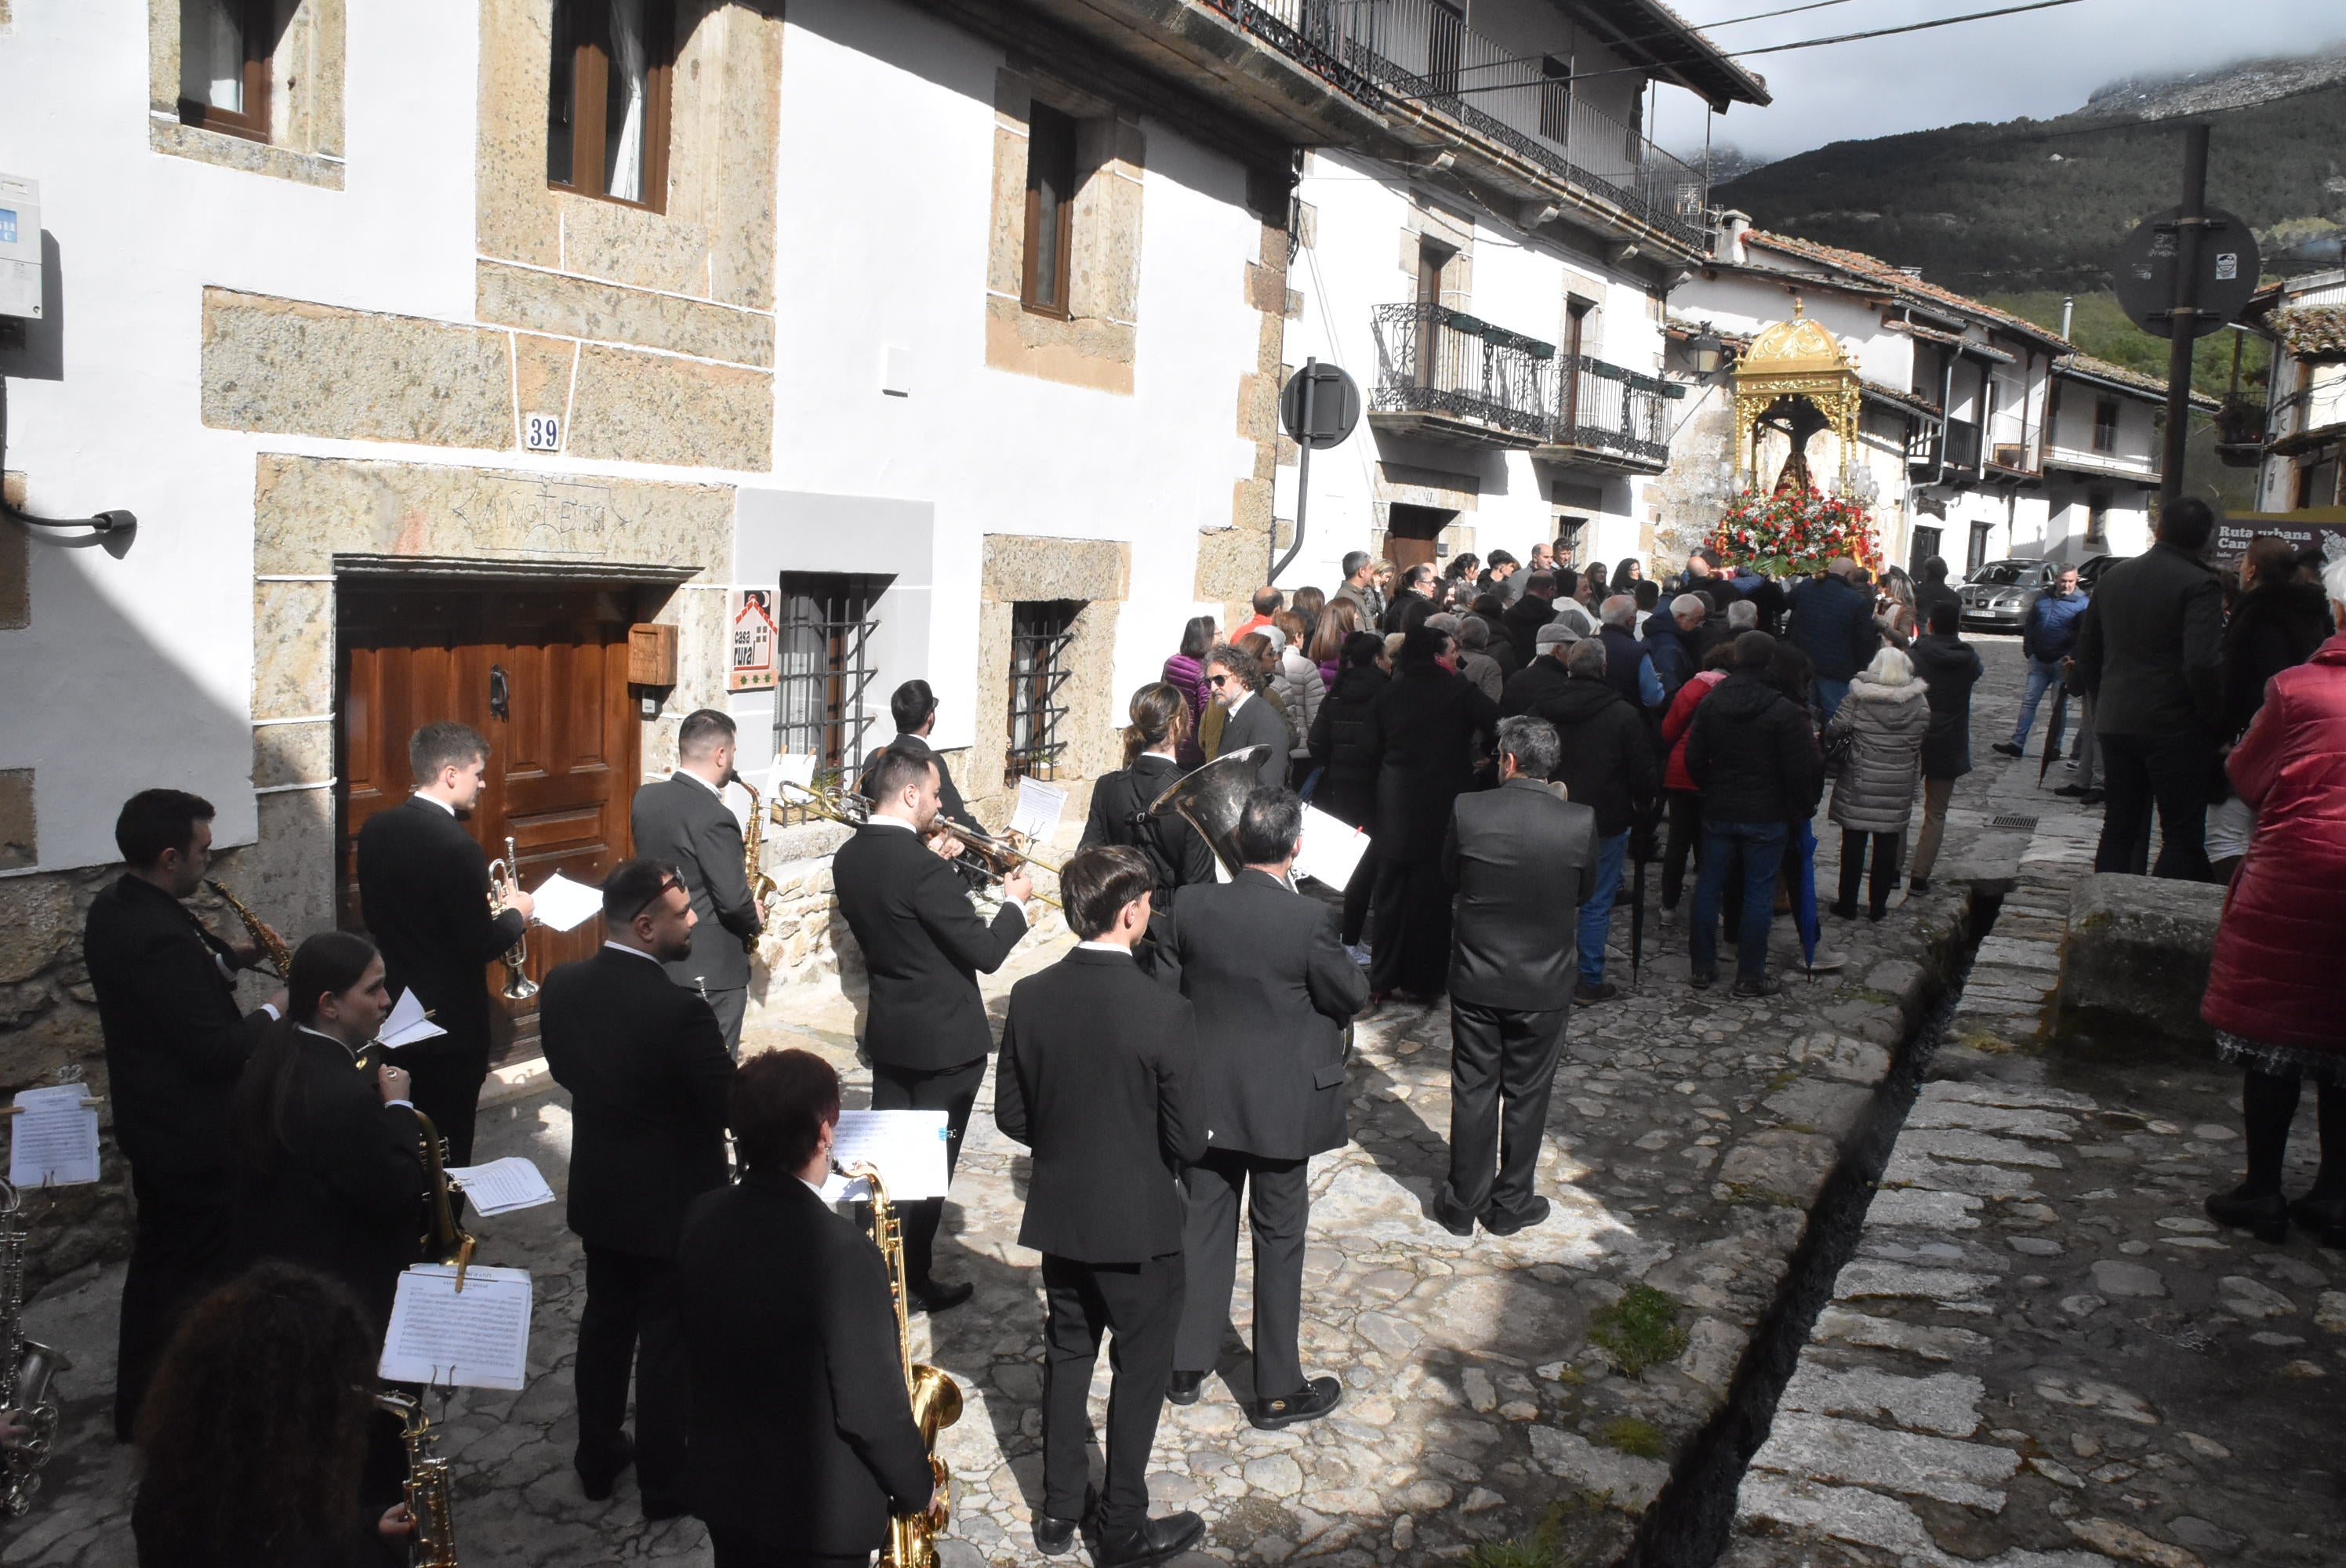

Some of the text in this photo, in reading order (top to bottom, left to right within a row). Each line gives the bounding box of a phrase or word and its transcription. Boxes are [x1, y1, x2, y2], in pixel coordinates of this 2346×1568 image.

[530, 418, 557, 447] 39
[2218, 525, 2254, 538] Ruta
[734, 630, 750, 644] casa
[734, 640, 756, 666] rural
